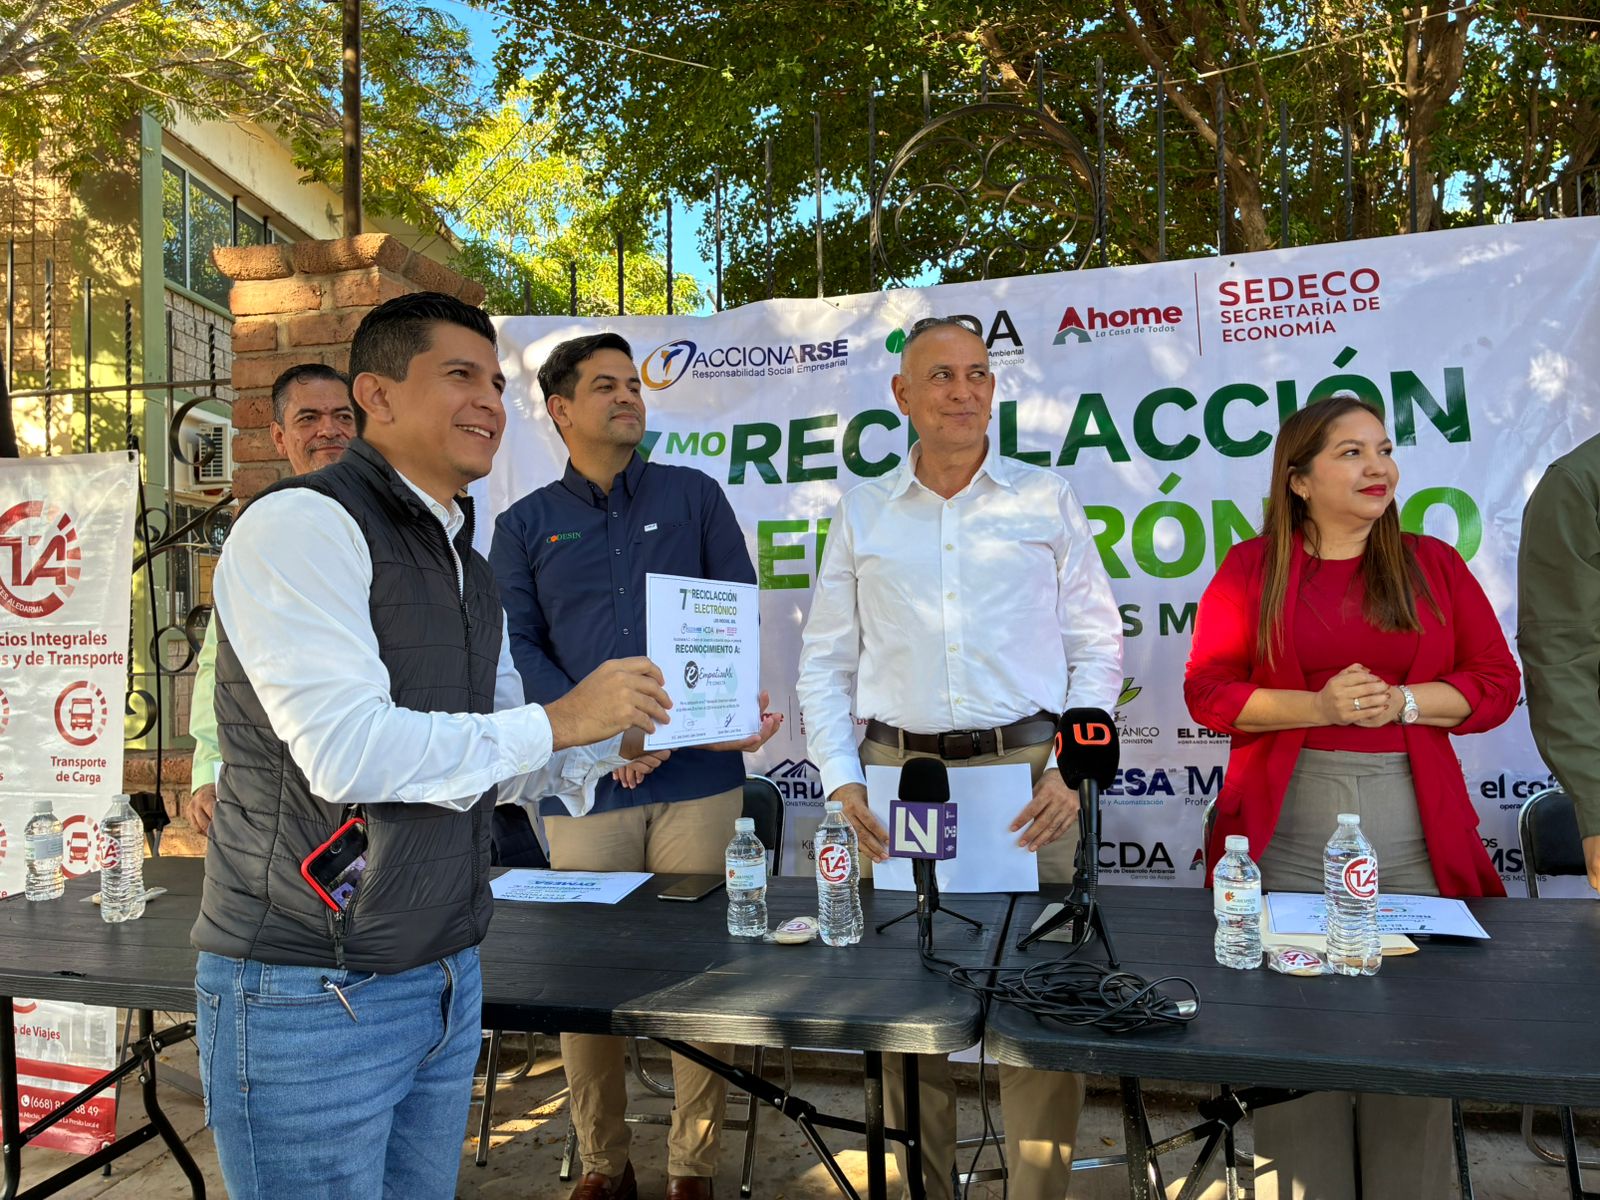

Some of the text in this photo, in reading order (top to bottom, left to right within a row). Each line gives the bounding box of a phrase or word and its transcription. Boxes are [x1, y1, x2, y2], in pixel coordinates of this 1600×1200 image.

[1218, 268, 1381, 306] SEDECO
[1220, 296, 1381, 324] SECRETARÍA DE
[947, 309, 1023, 349] DA
[1054, 305, 1183, 337] Ahome
[1095, 325, 1175, 338] La Casa de Todos
[1222, 320, 1337, 343] ECONOMÍA
[692, 338, 848, 369] ACCIONARSE
[988, 348, 1024, 358] Ambiental
[998, 358, 1025, 366] Acopio
[692, 358, 848, 380] Responsabilidad Social Empresarial
[728, 346, 1472, 485] RECLACCIÓN
[692, 588, 737, 602] RECICLACCIÓN
[694, 602, 737, 616] ELECTRÓNICO
[0, 630, 107, 650] cios Integrales
[675, 644, 733, 654] RECONOCIMIENTO
[12, 654, 22, 669] y
[25, 650, 45, 665] de
[48, 650, 124, 668] Transporte
[1117, 724, 1160, 737] TÁNICO
[1177, 728, 1195, 738] EL
[51, 756, 107, 769] Transporte
[56, 771, 101, 785] de Carga
[1099, 767, 1176, 796] ESA
[1480, 773, 1506, 799] el
[1114, 799, 1164, 807] Automatización
[1098, 842, 1175, 868] CDA
[20, 1024, 31, 1035] de
[33, 1026, 61, 1041] Viajes
[31, 1095, 53, 1111] (668)
[87, 1105, 99, 1117] 49
